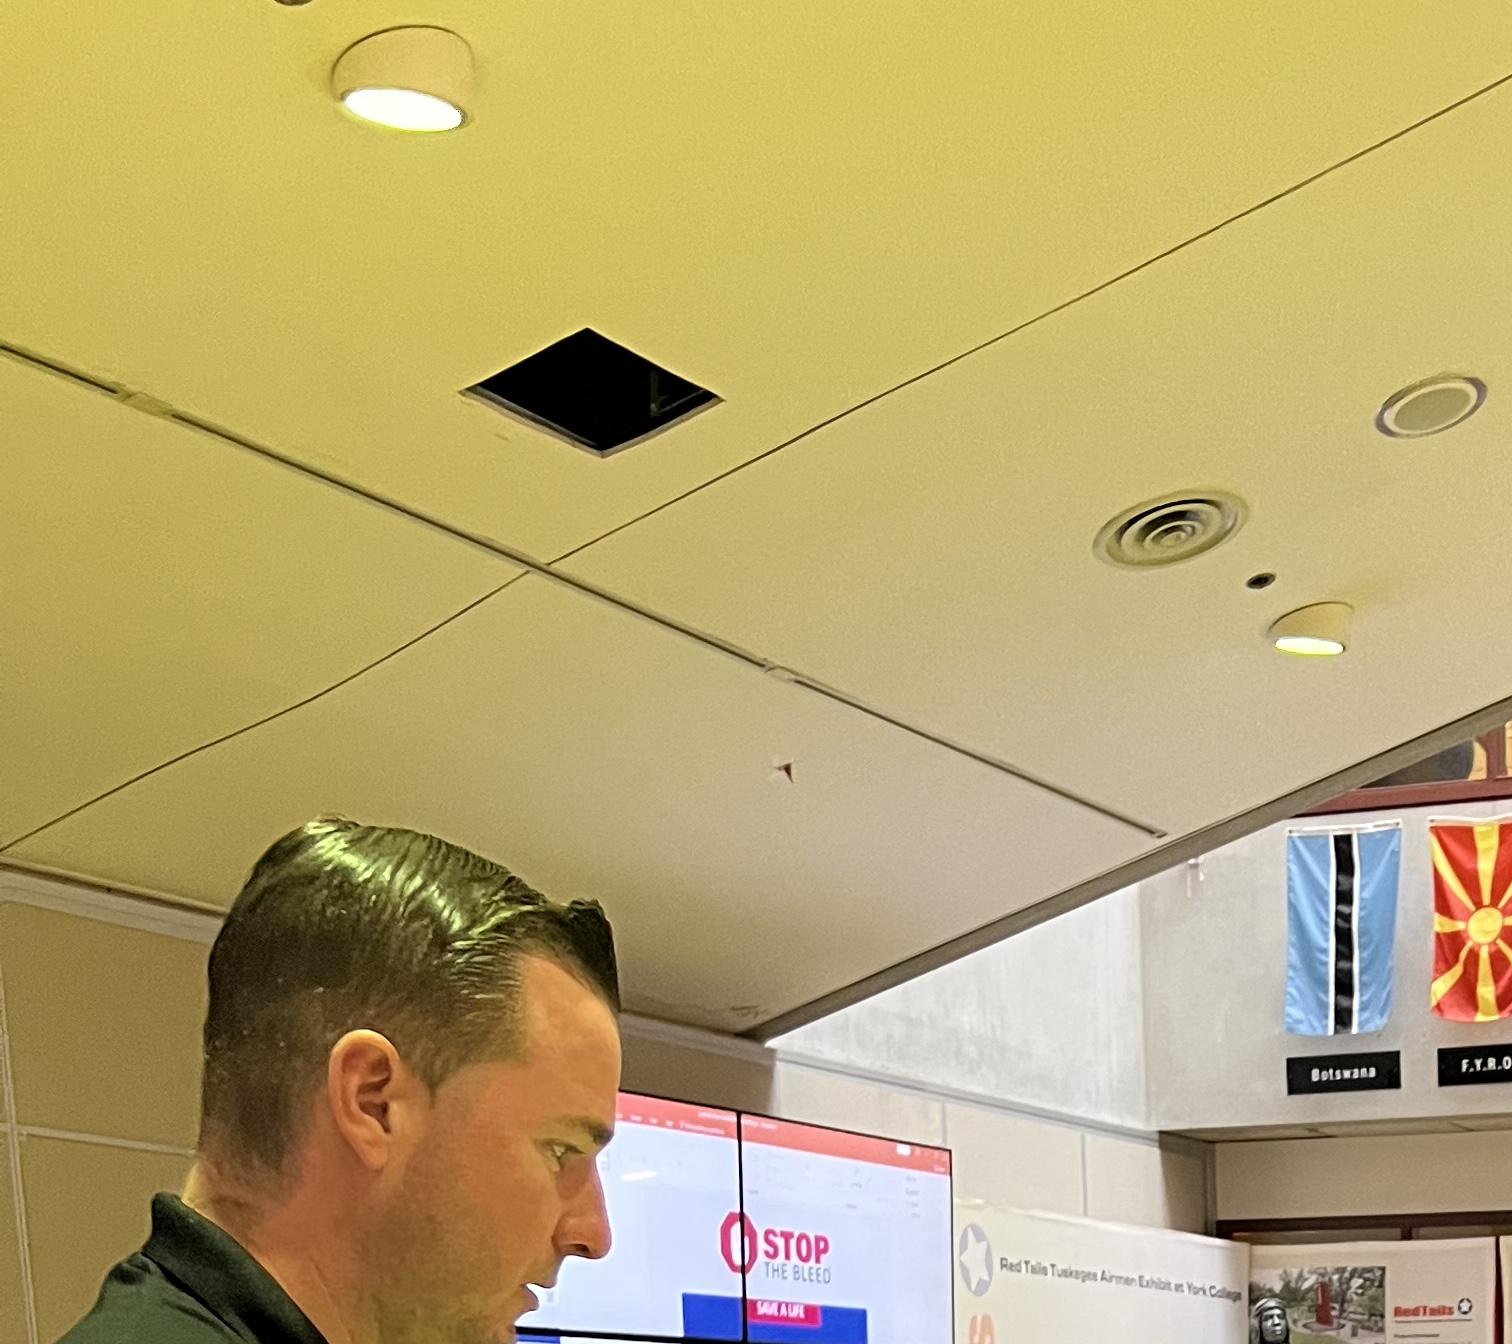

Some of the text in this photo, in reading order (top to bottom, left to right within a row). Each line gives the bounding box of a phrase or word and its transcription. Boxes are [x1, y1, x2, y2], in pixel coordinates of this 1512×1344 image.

[1310, 1066, 1377, 1083] Botswana
[762, 1227, 831, 1265] STOP
[764, 1262, 832, 1285] THE BLEED
[1000, 1257, 1022, 1273] Red
[1023, 1259, 1049, 1277] Tails
[1099, 1269, 1137, 1287] Airmen
[1138, 1275, 1173, 1292] Exhibit
[1174, 1282, 1185, 1294] at
[1186, 1281, 1207, 1296] York
[1208, 1285, 1243, 1302] College
[756, 1301, 779, 1317] SAVE
[788, 1304, 806, 1319] LIFE
